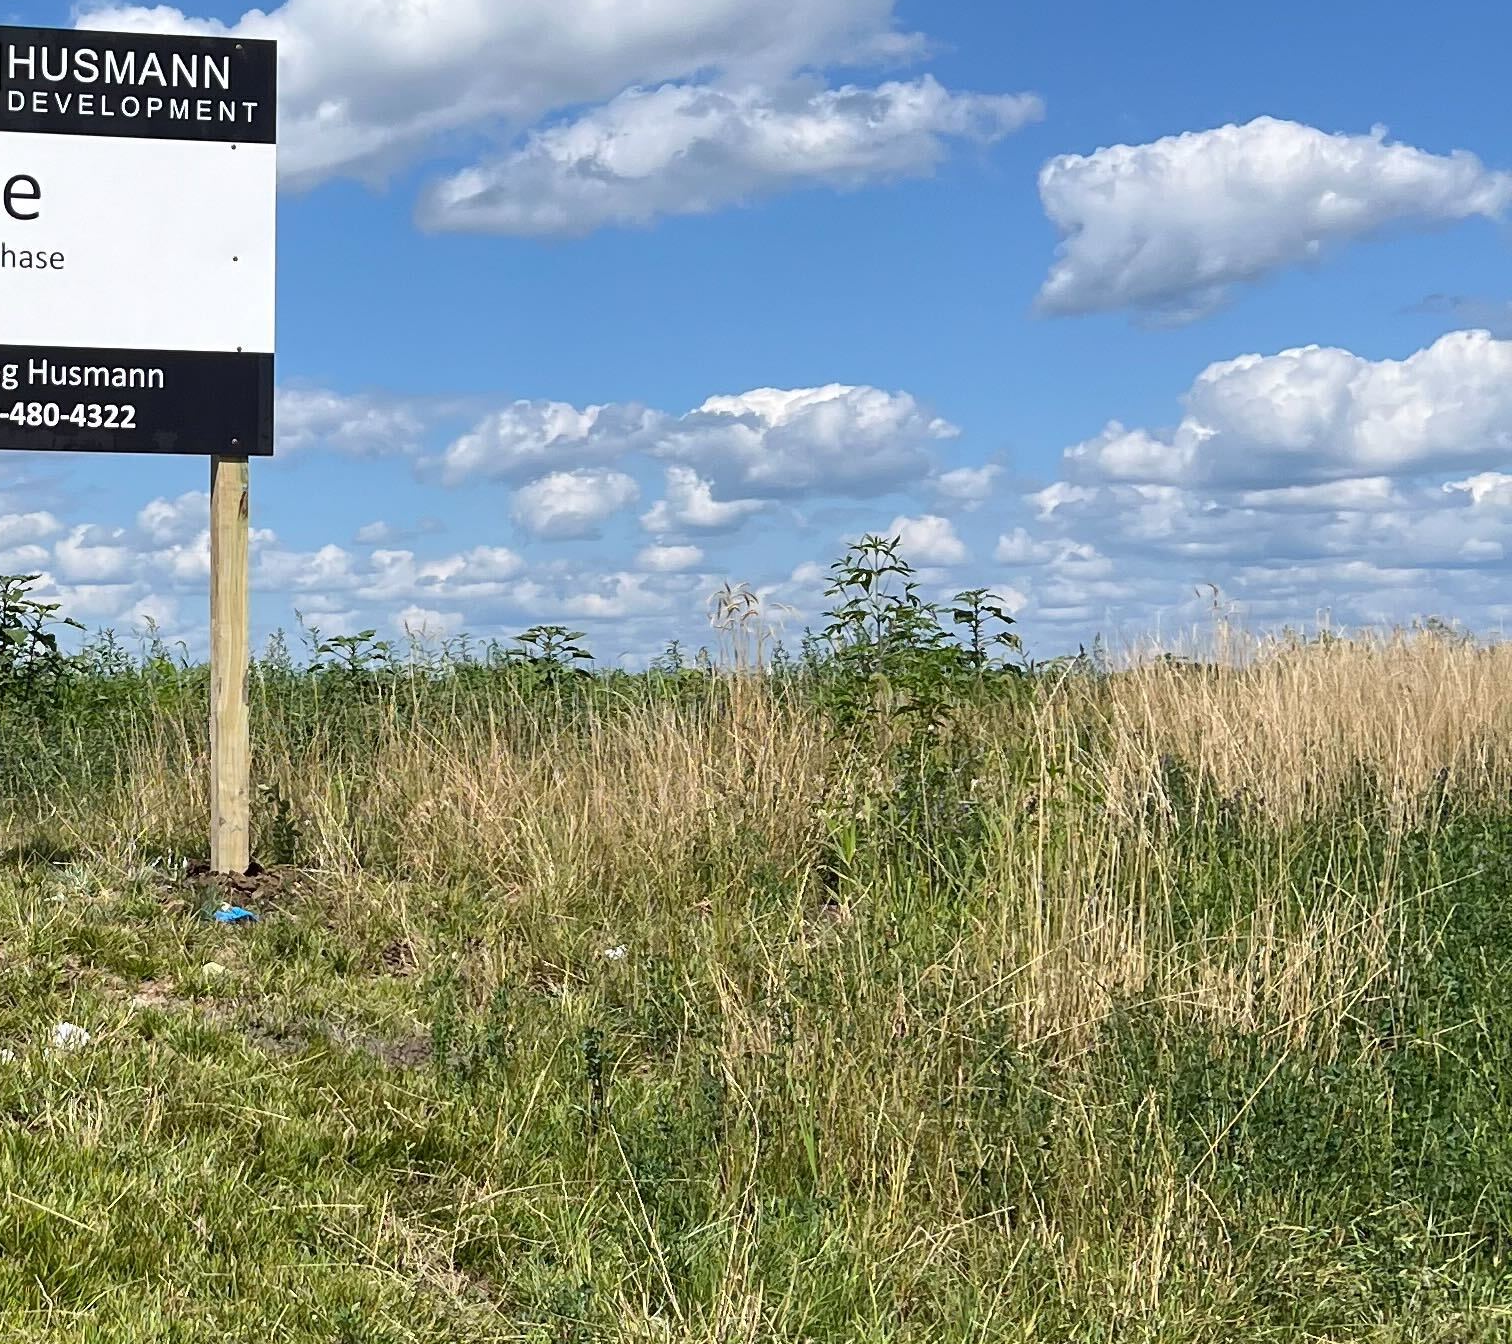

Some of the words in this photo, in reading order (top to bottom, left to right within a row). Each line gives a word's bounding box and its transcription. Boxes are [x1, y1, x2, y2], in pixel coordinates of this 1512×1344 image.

[8, 44, 230, 90] HUSMANN
[8, 90, 258, 123] DEVELOPMENT
[28, 358, 164, 389] Husmann
